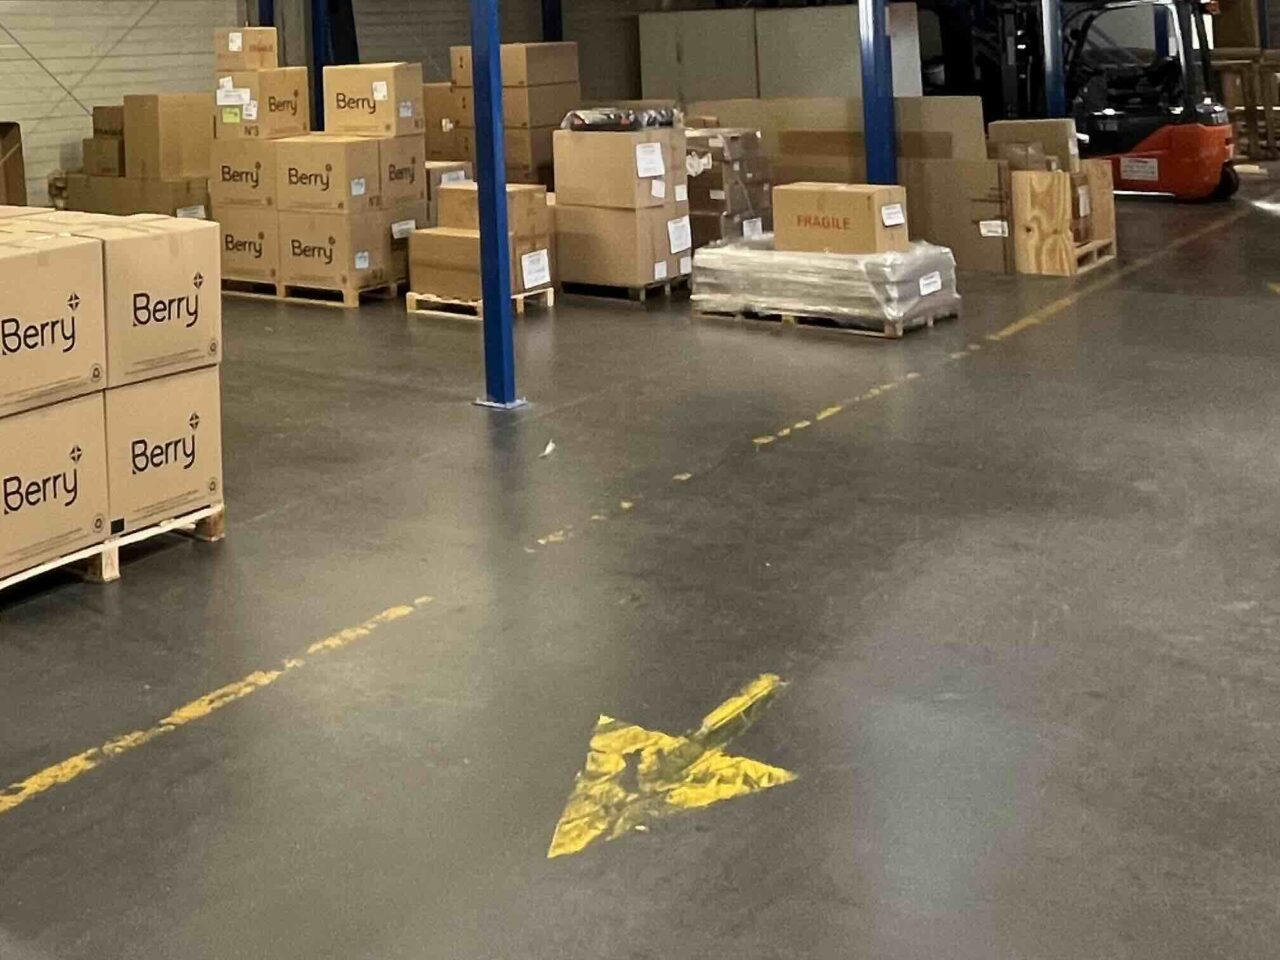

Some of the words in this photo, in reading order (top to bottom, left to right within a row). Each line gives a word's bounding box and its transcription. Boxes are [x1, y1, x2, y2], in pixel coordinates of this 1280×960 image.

[269, 96, 298, 116] Berry
[336, 93, 377, 114] Berry
[221, 165, 259, 189] Berry
[288, 168, 330, 191] Berry
[388, 164, 416, 184] Berry
[796, 214, 851, 230] FRAGILE
[225, 234, 263, 258] Berry
[291, 239, 333, 265] Berry
[132, 292, 199, 328] Berry
[1, 316, 76, 356] Berry
[132, 434, 196, 475] Berry
[3, 468, 78, 515] Berry
